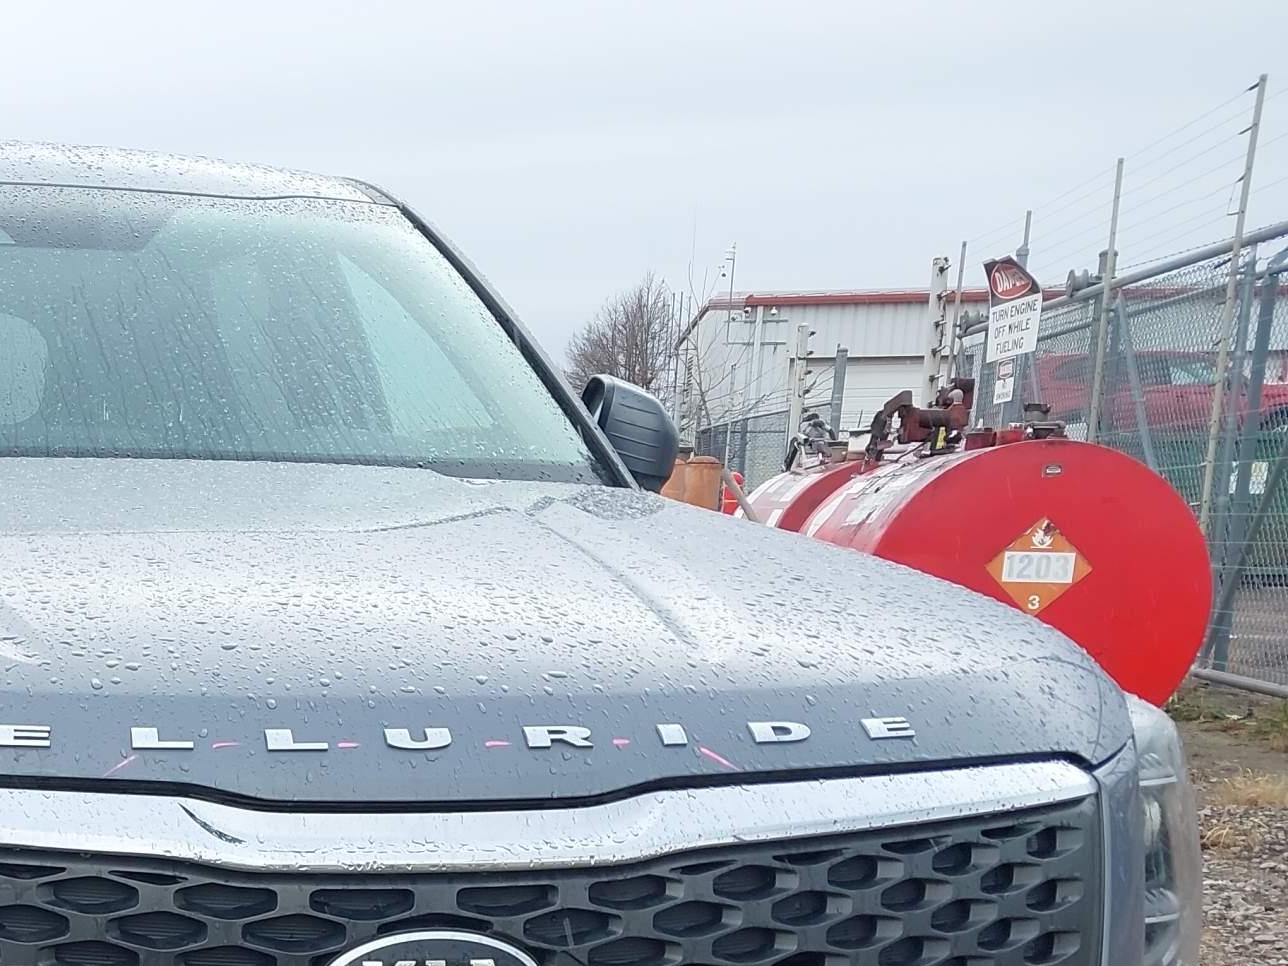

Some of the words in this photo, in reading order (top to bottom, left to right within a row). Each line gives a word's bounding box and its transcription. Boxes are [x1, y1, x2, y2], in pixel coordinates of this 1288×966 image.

[992, 305, 1009, 323] TURN
[1010, 299, 1039, 317] ENGINE
[994, 325, 1007, 339] OFF
[1008, 317, 1031, 335] WHILE
[996, 336, 1024, 355] FUELING
[1006, 554, 1070, 579] 1203
[1027, 595, 1040, 610] 3
